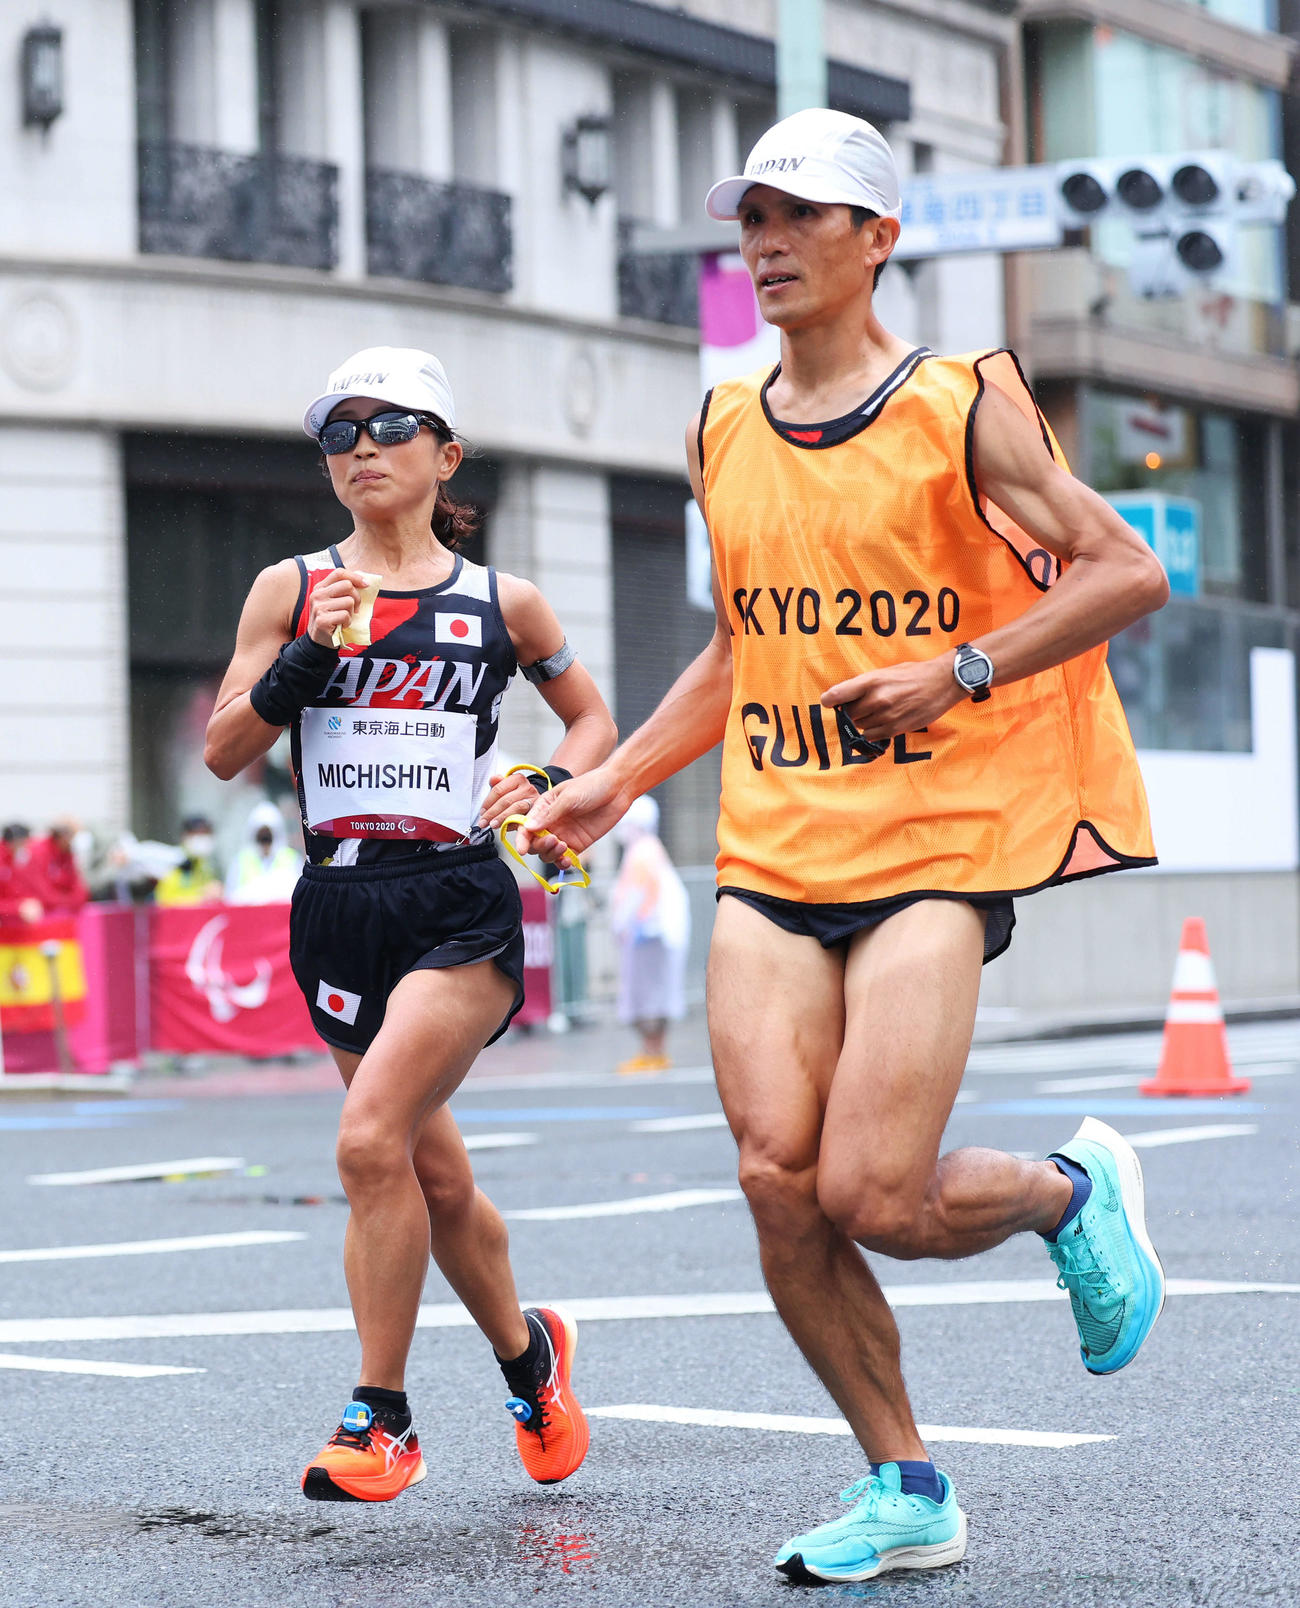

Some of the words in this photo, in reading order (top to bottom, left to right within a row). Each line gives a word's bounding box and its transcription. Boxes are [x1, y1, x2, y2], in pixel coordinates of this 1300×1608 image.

[835, 586, 960, 637] 2020
[316, 656, 489, 710] APAN
[352, 720, 445, 738] 東京海上日動
[317, 763, 451, 792] MICHISHITA
[350, 821, 375, 831] TOKYO
[375, 822, 396, 831] 2020
